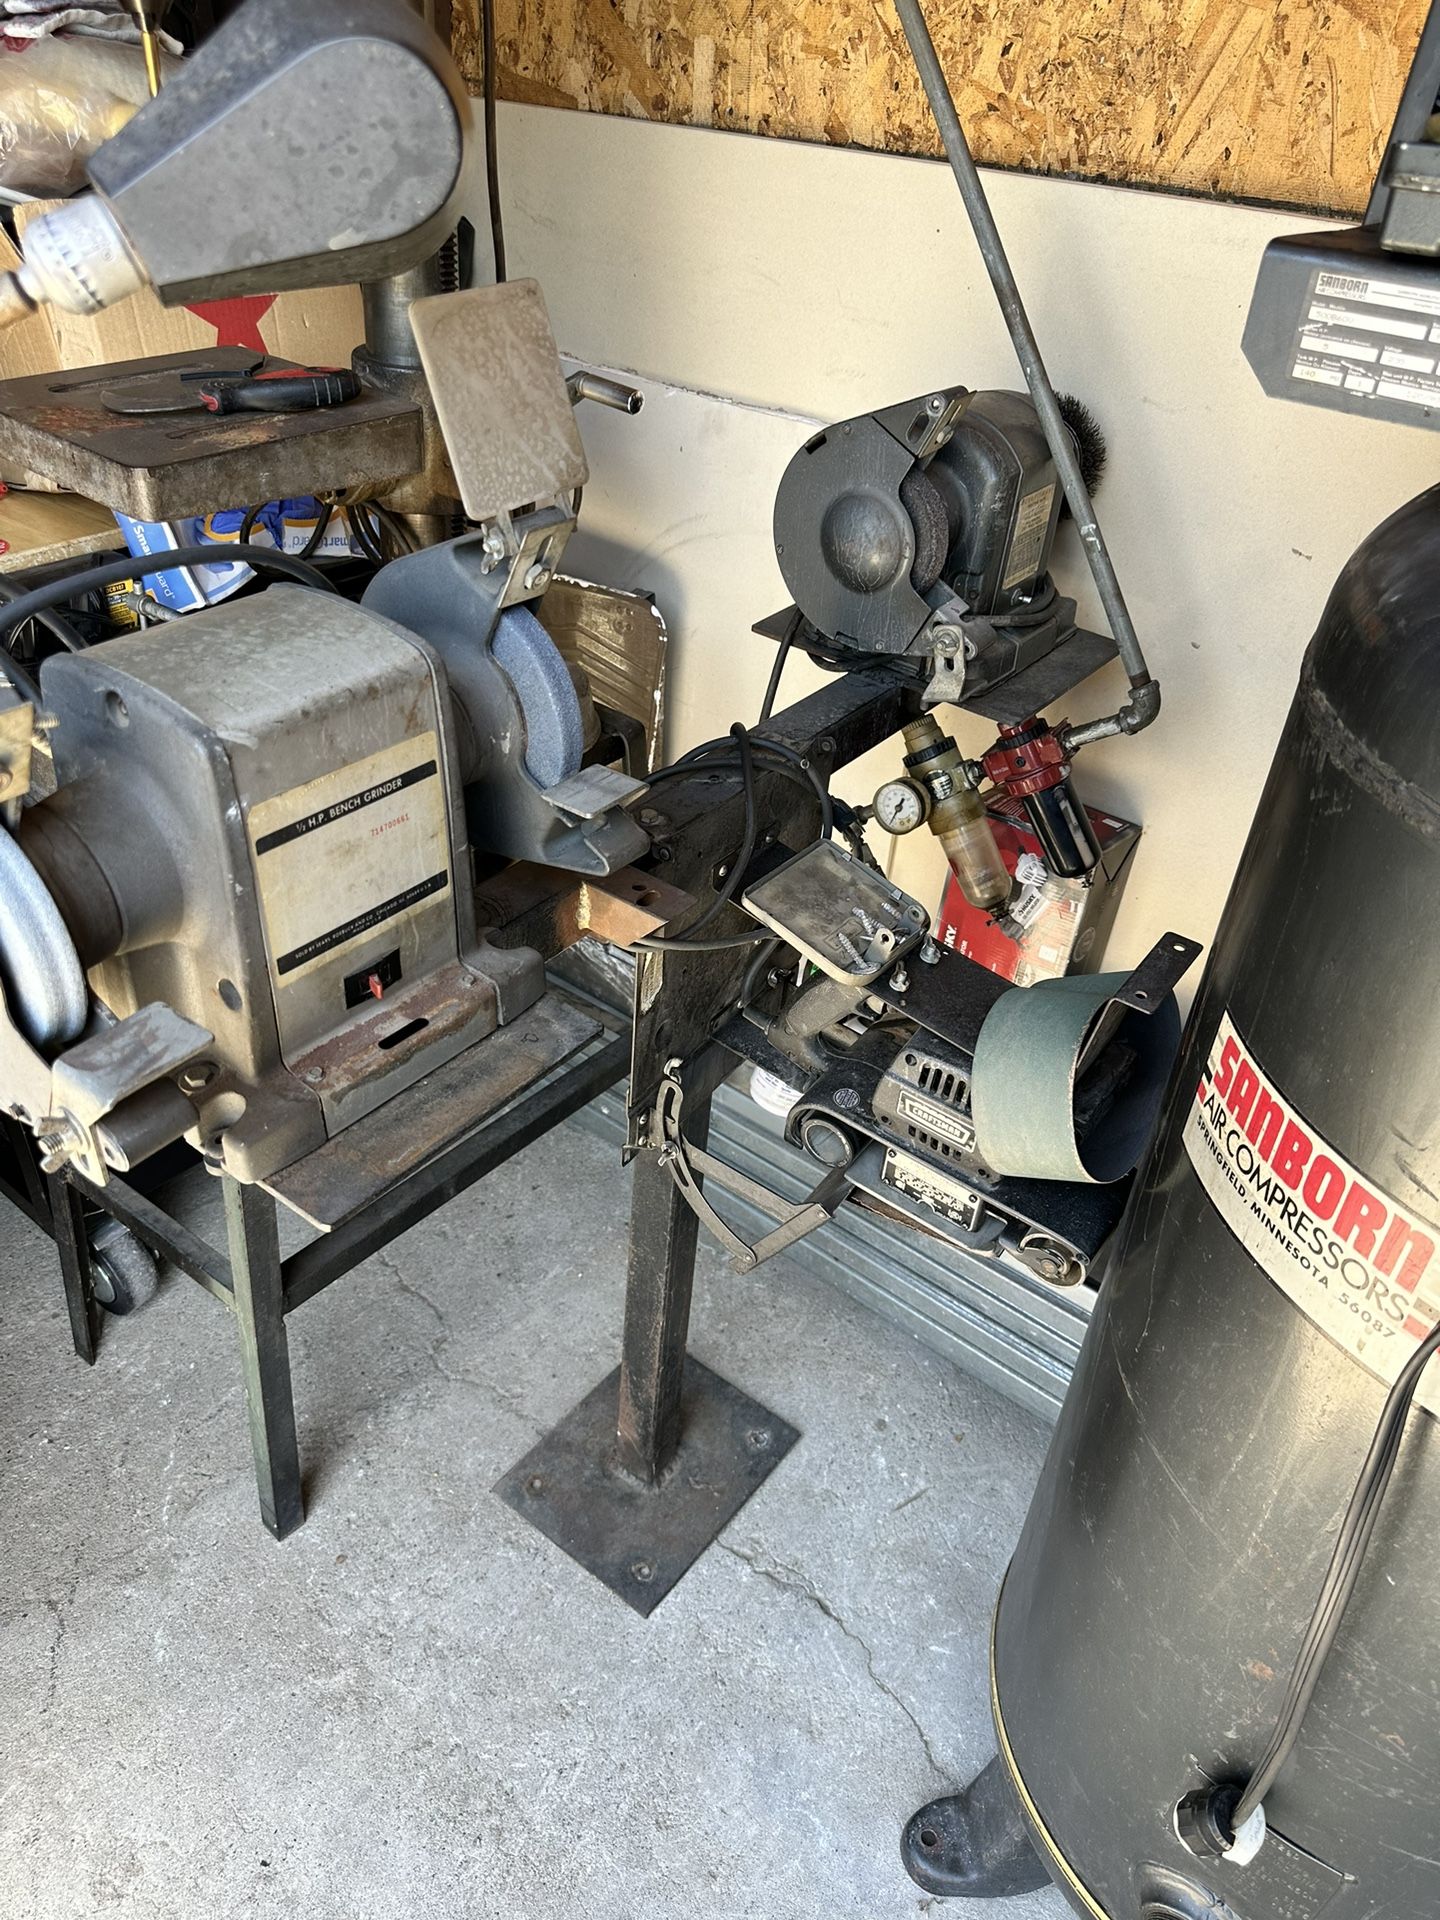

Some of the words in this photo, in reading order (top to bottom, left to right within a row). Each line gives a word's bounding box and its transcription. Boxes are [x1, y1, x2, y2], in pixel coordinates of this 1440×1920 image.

[1318, 275, 1369, 294] SANBORN
[308, 813, 327, 828] H.P.
[329, 797, 361, 818] BENCH
[363, 778, 403, 802] GRINDER
[354, 918, 365, 928] AND
[1020, 893, 1037, 913] HUSKY
[912, 1106, 962, 1140] CRAFTSMAN
[1213, 1035, 1435, 1293] SANBORN
[1197, 1114, 1248, 1204] SPRINGFIELD,
[1250, 1201, 1329, 1290] MINNESOTA
[1338, 1292, 1397, 1339] 56087
[1204, 1093, 1227, 1140] AIR
[1227, 1130, 1410, 1322] COMPRESSORS
